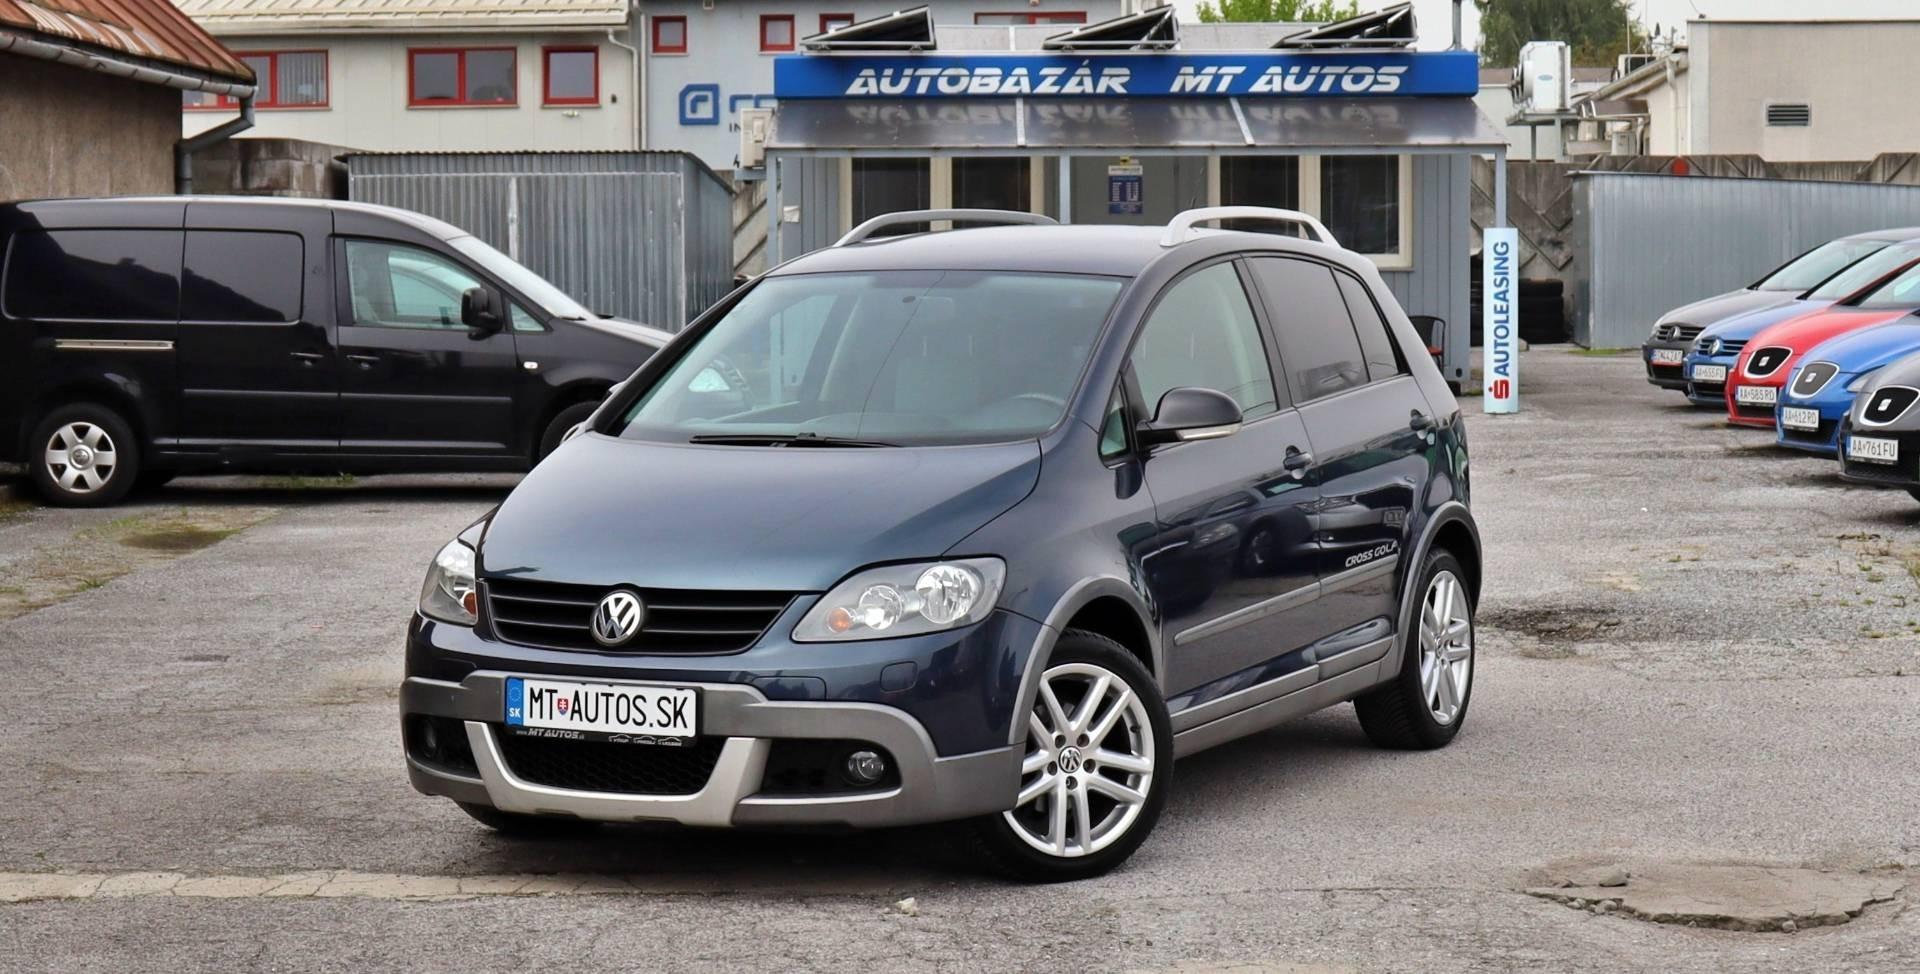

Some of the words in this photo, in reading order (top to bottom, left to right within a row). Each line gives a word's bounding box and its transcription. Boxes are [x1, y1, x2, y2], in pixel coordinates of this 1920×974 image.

[845, 59, 1131, 95] AUTOBAZÁR
[1169, 65, 1247, 93] MT
[1248, 65, 1409, 93] AUTOS
[1493, 241, 1510, 377] AUTOLEASING
[1345, 549, 1374, 568] CROSS
[509, 707, 521, 718] SK
